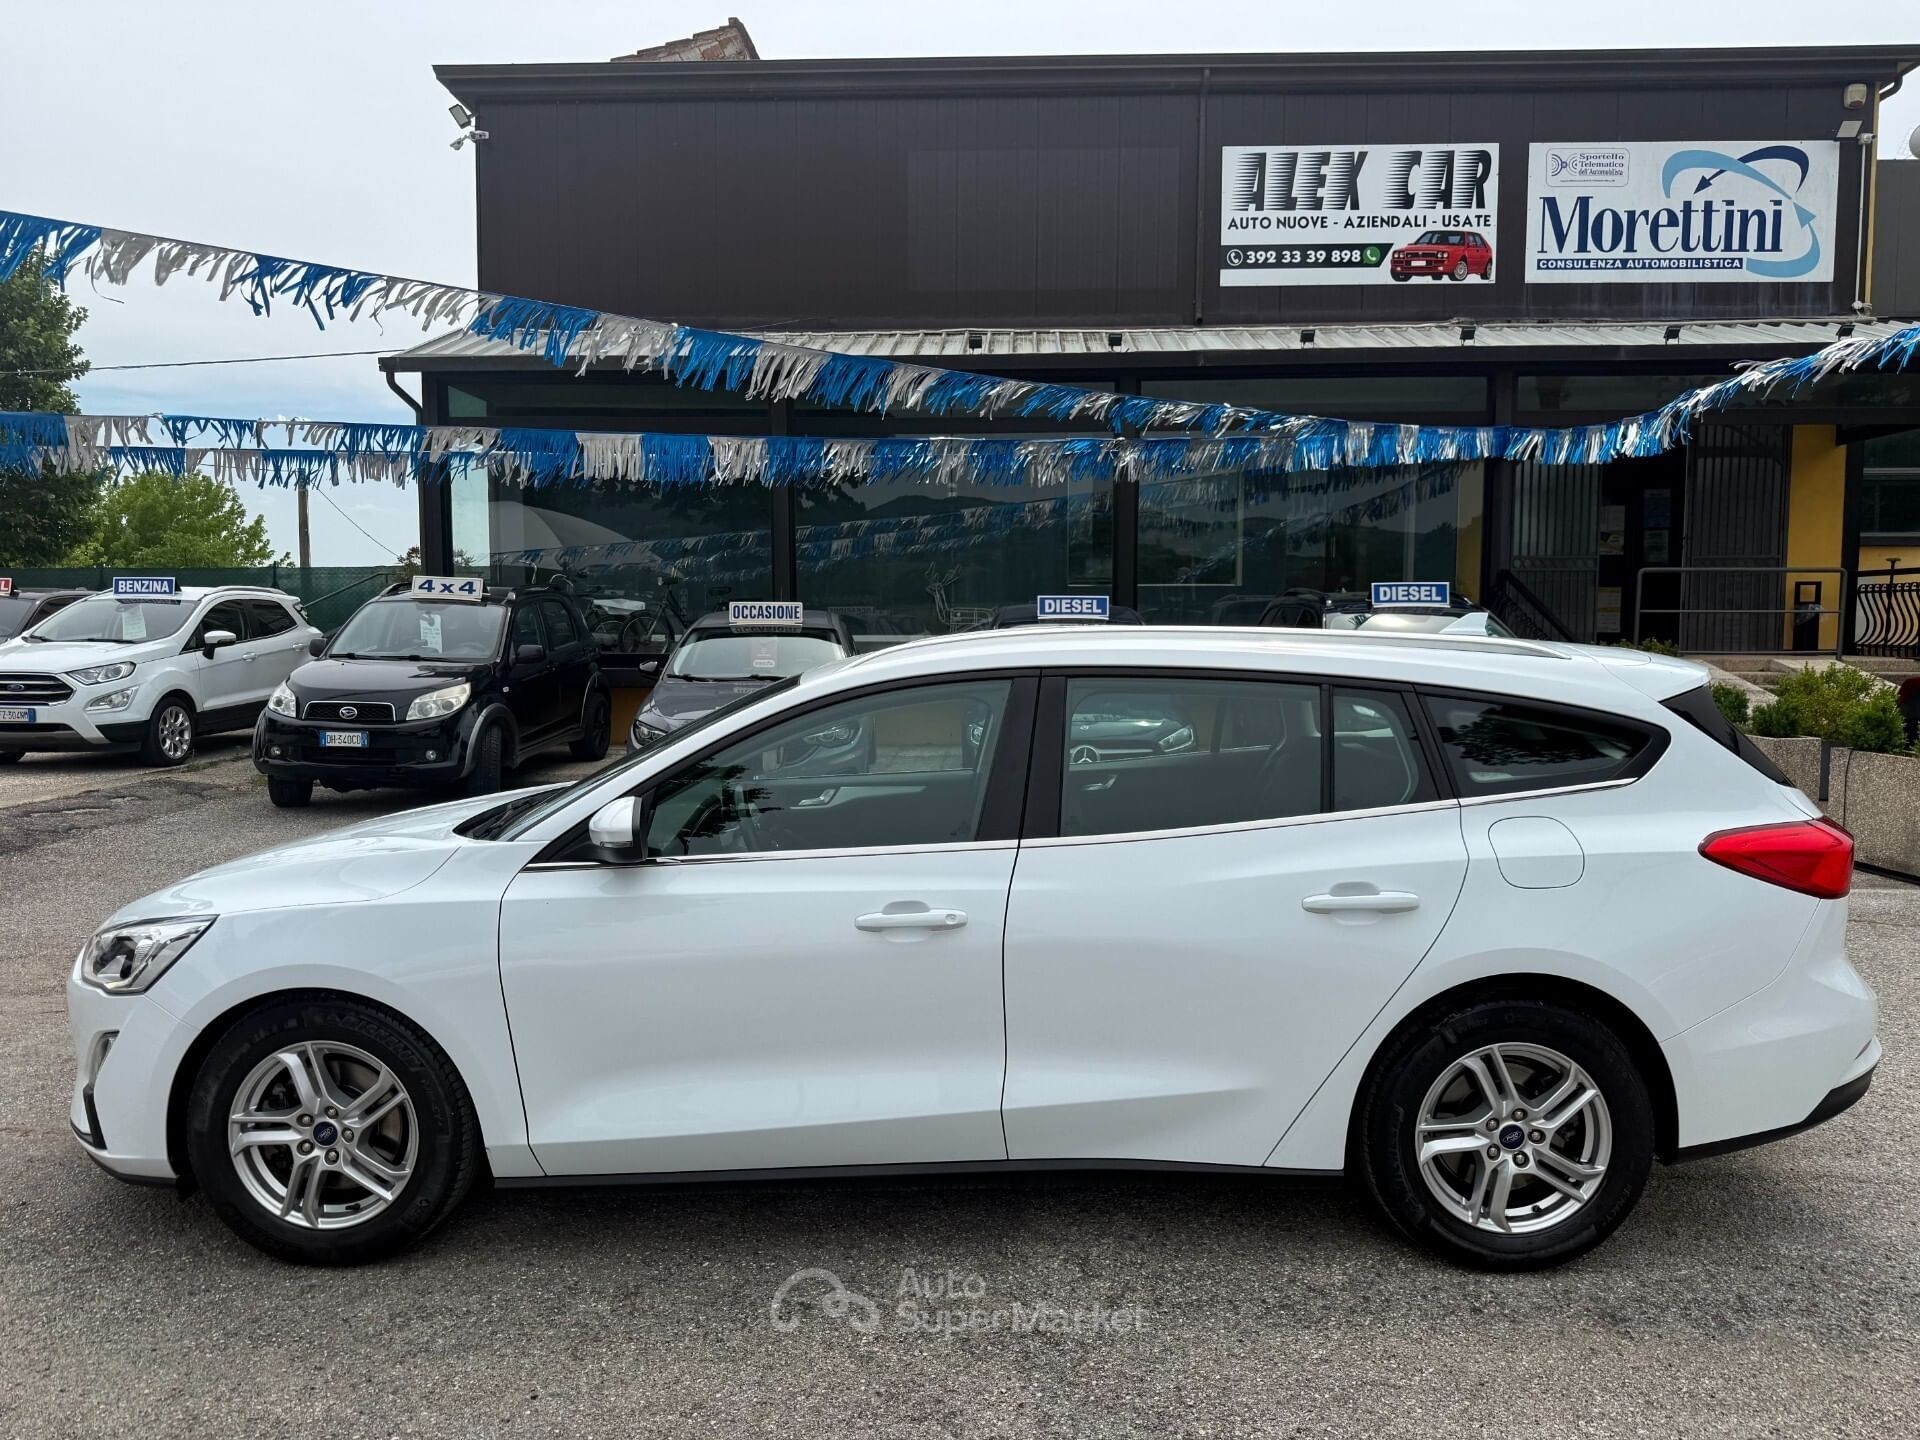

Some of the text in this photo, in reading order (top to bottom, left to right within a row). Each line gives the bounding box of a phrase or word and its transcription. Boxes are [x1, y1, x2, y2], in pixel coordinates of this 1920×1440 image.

[1579, 153, 1624, 161] Sportello
[1229, 150, 1492, 211] ALEX CAR
[1227, 216, 1272, 230] AUTO
[1276, 216, 1328, 230] NUOVE
[1343, 215, 1427, 229] AZIENDALI
[1442, 214, 1492, 228] USATE
[1537, 196, 1783, 253] Morettini
[1246, 250, 1361, 264] 392 33 39 898
[1539, 259, 1741, 269] CONSULENZA AUTOMOBILISTICA
[118, 580, 170, 593] BENZINA
[1379, 586, 1442, 601] DIESEL
[732, 604, 800, 619] OCCASIONE
[1044, 599, 1102, 613] DIESEL
